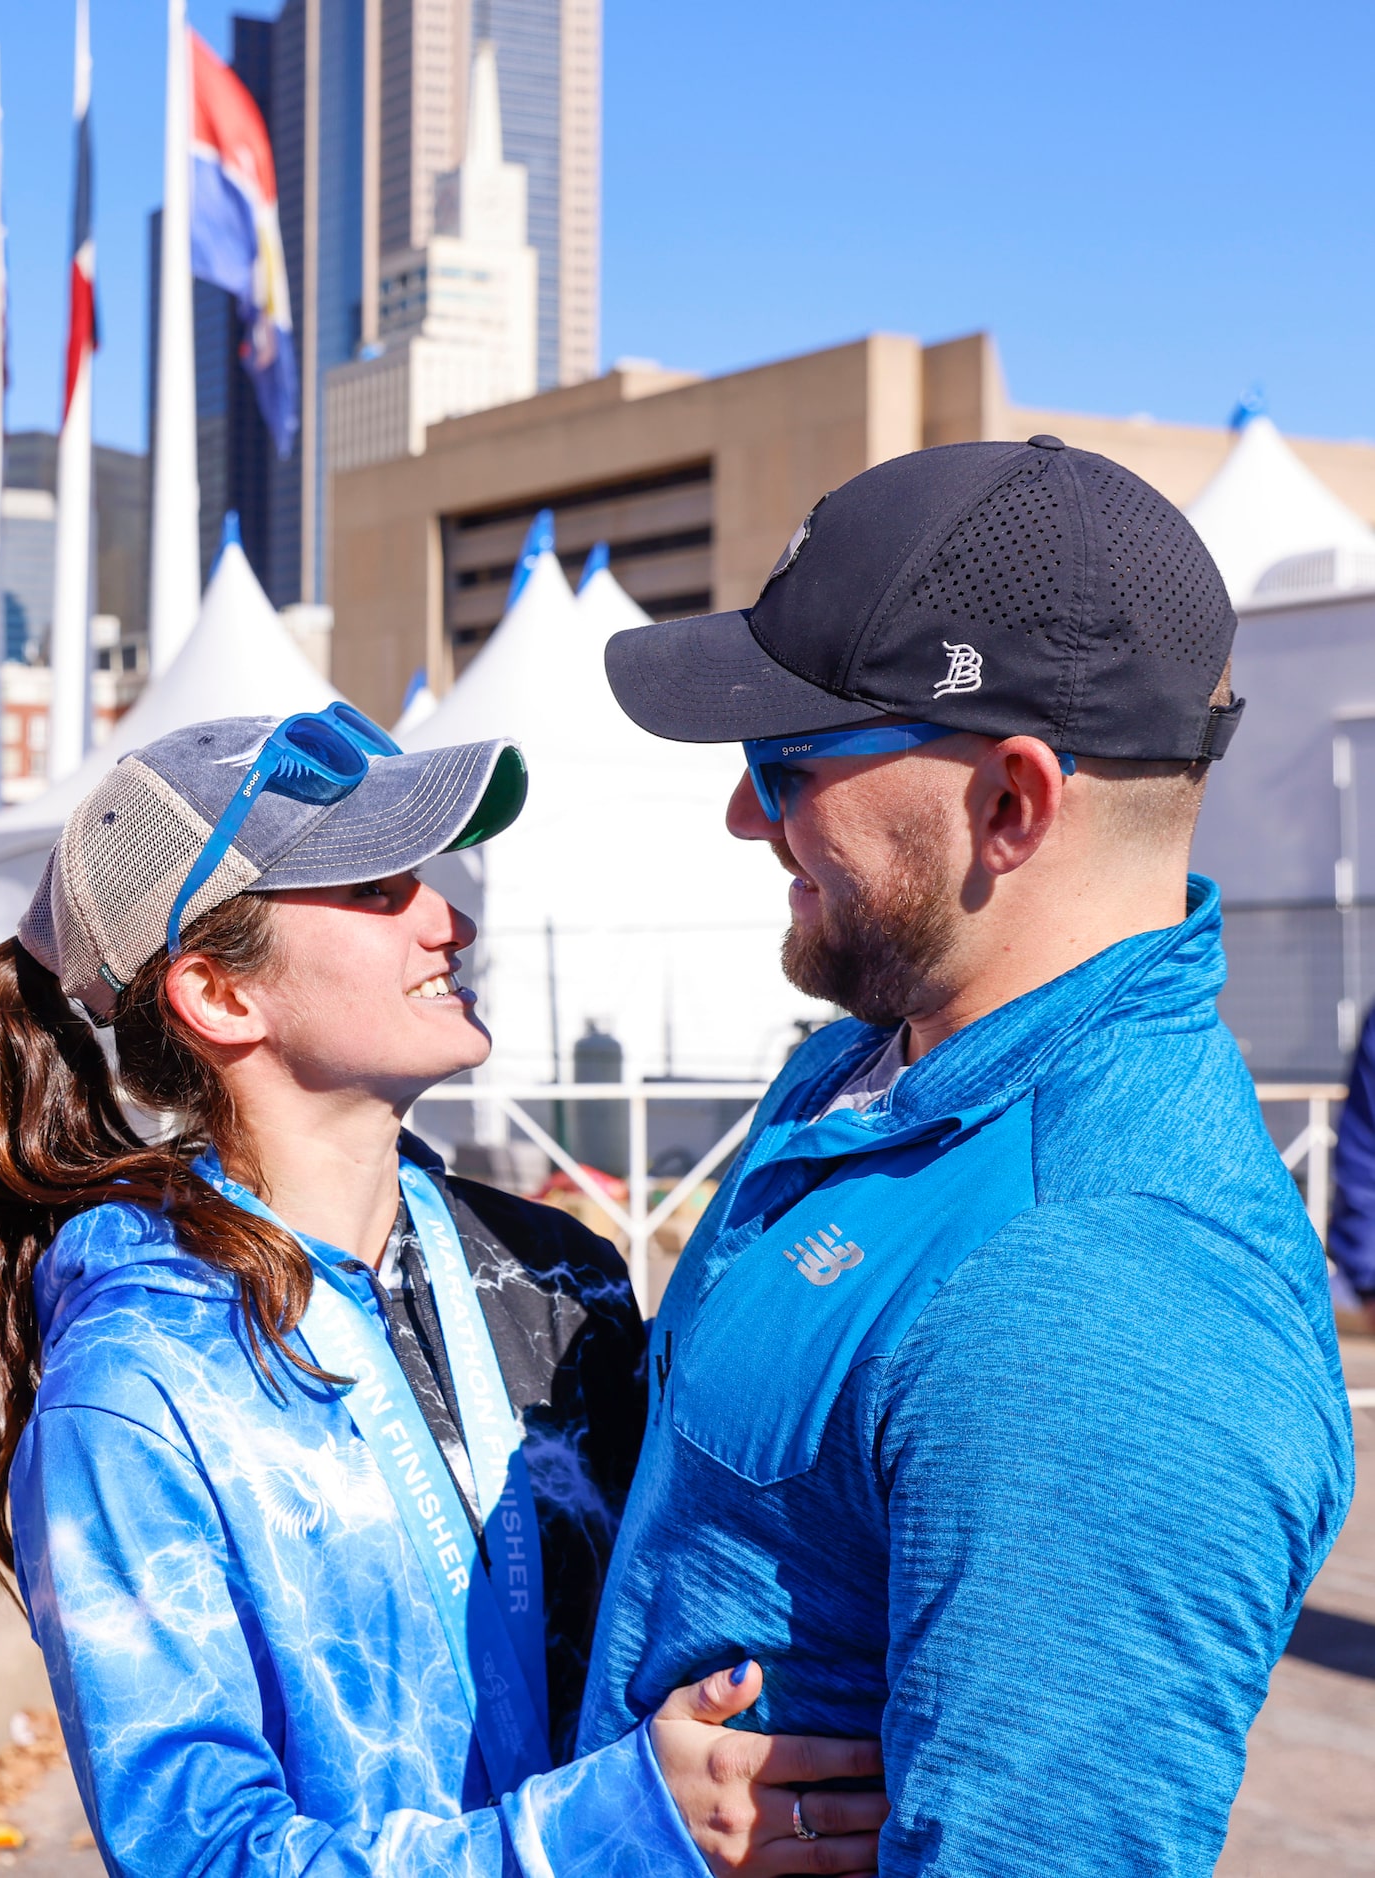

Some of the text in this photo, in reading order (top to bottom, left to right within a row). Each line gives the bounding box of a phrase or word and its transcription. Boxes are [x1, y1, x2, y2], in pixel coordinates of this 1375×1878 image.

[782, 743, 813, 756] goodr
[242, 771, 261, 797] goodr
[381, 1418, 470, 1597] FINISHER
